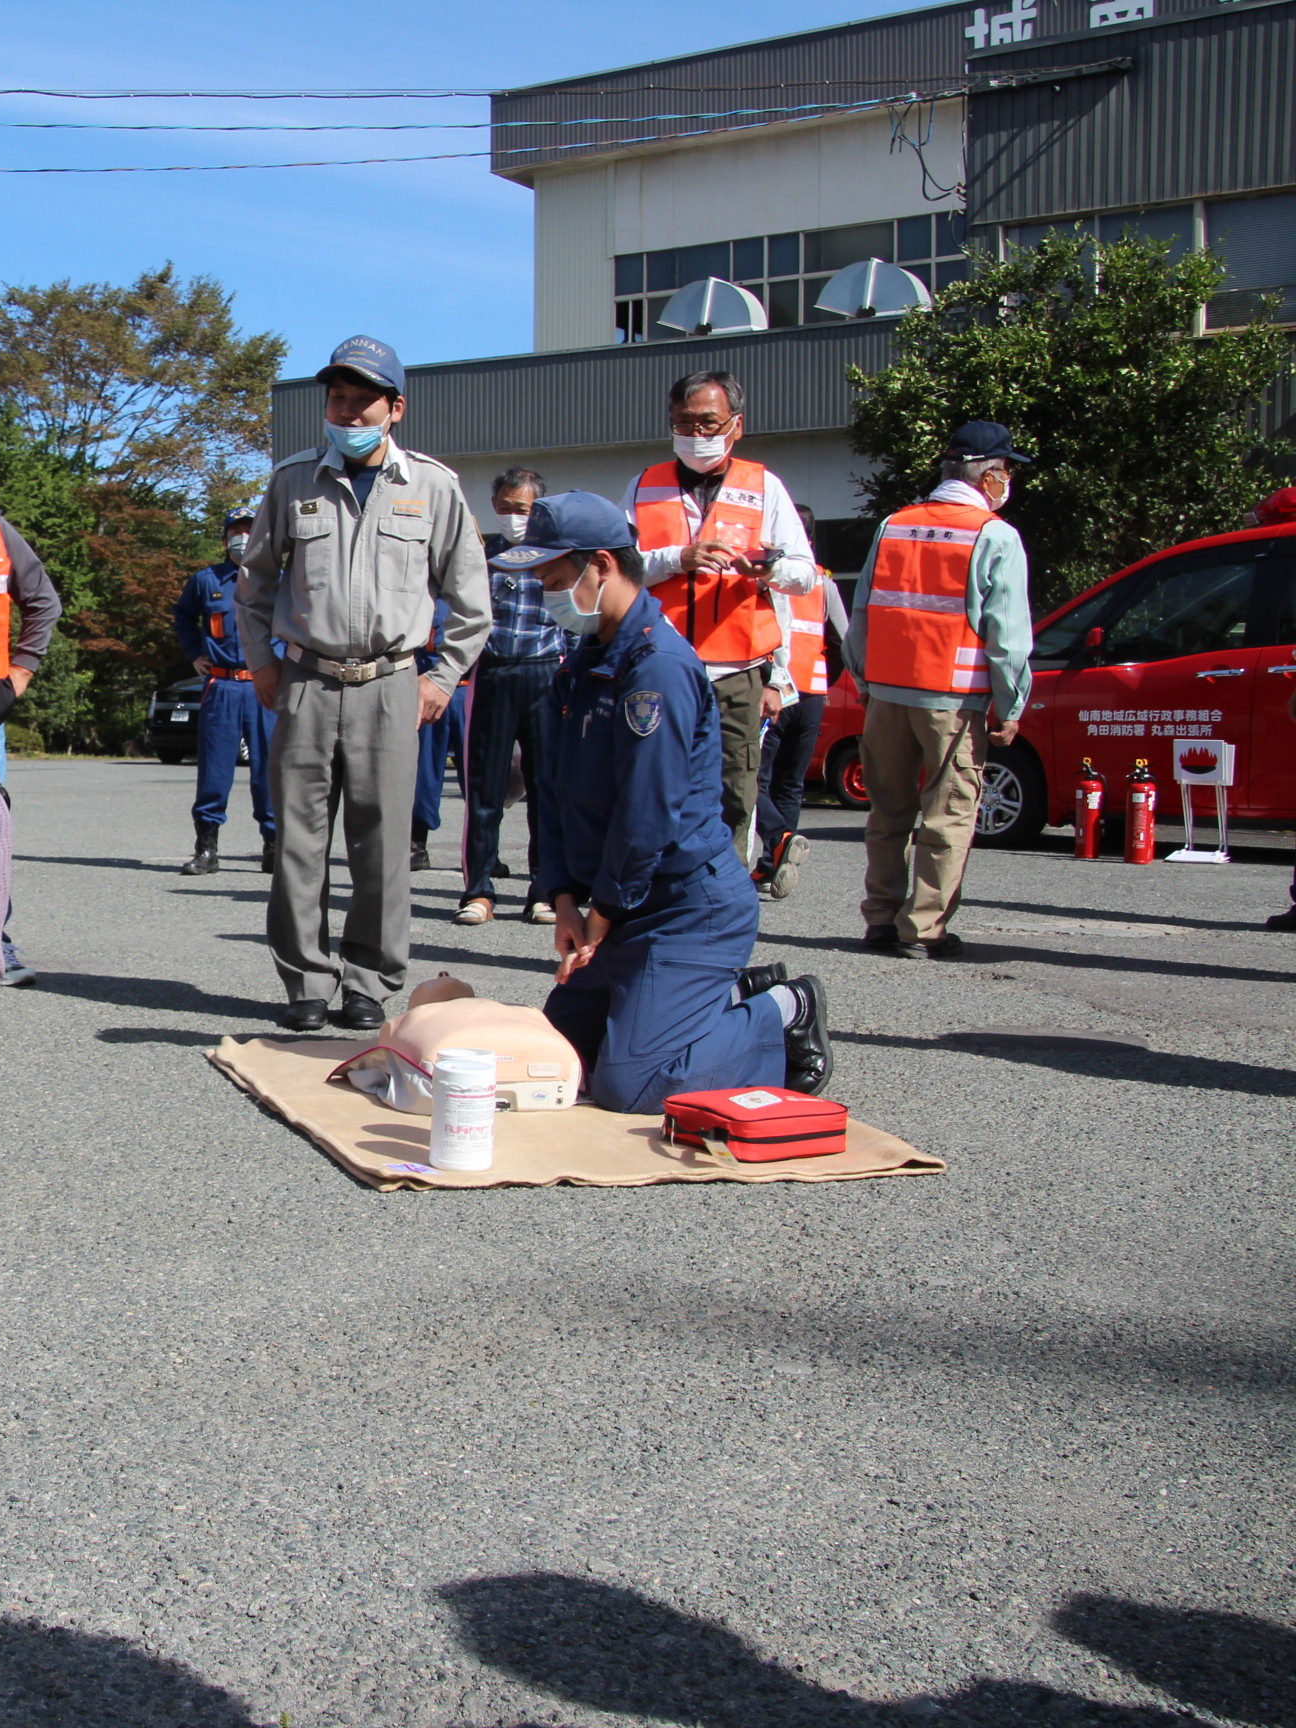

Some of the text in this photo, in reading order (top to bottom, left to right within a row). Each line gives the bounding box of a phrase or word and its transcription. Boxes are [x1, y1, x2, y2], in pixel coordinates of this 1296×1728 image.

[908, 528, 955, 540] 丸森町
[1078, 710, 1223, 722] 仙南地域広域行政事務組合
[1087, 724, 1212, 736] 角田消防署 丸森出張所
